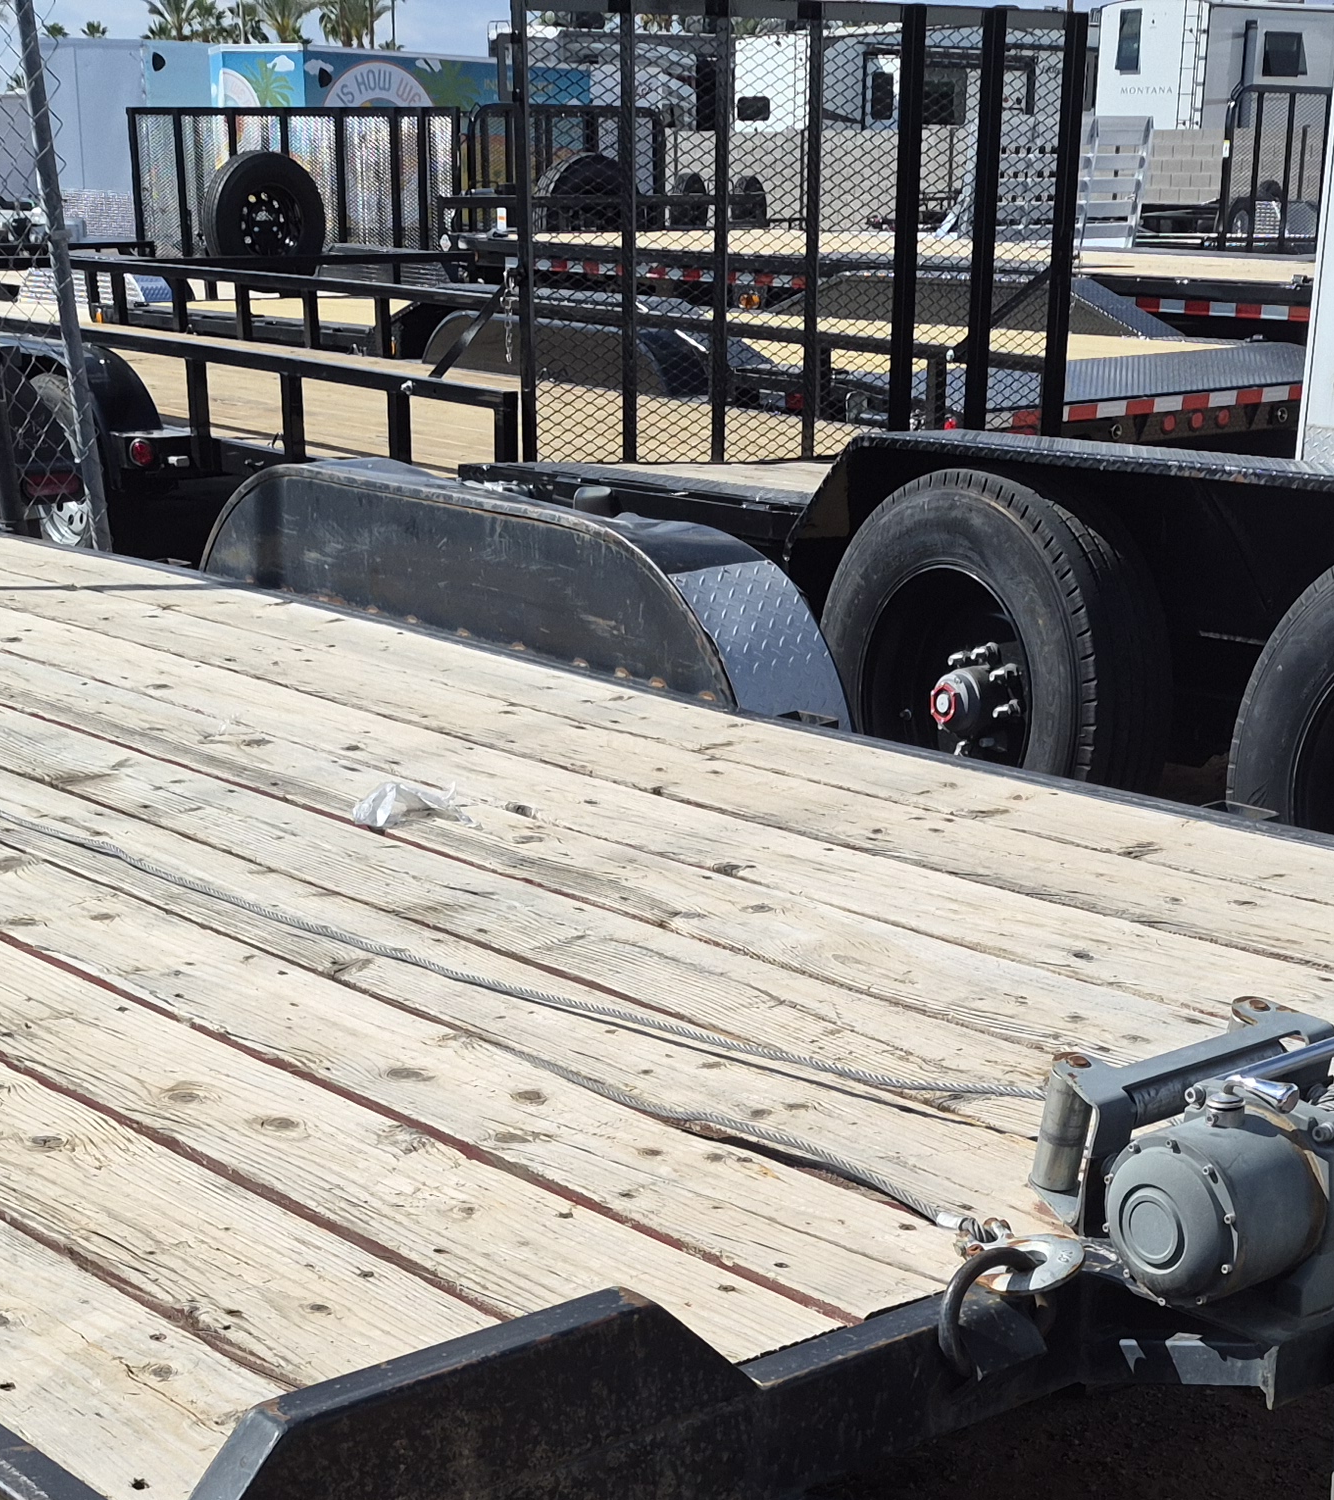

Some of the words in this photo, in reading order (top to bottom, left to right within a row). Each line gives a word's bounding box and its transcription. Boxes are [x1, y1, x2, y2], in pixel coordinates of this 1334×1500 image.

[336, 83, 355, 106] IS
[354, 68, 392, 95] HOW
[1120, 86, 1173, 95] MONTANA
